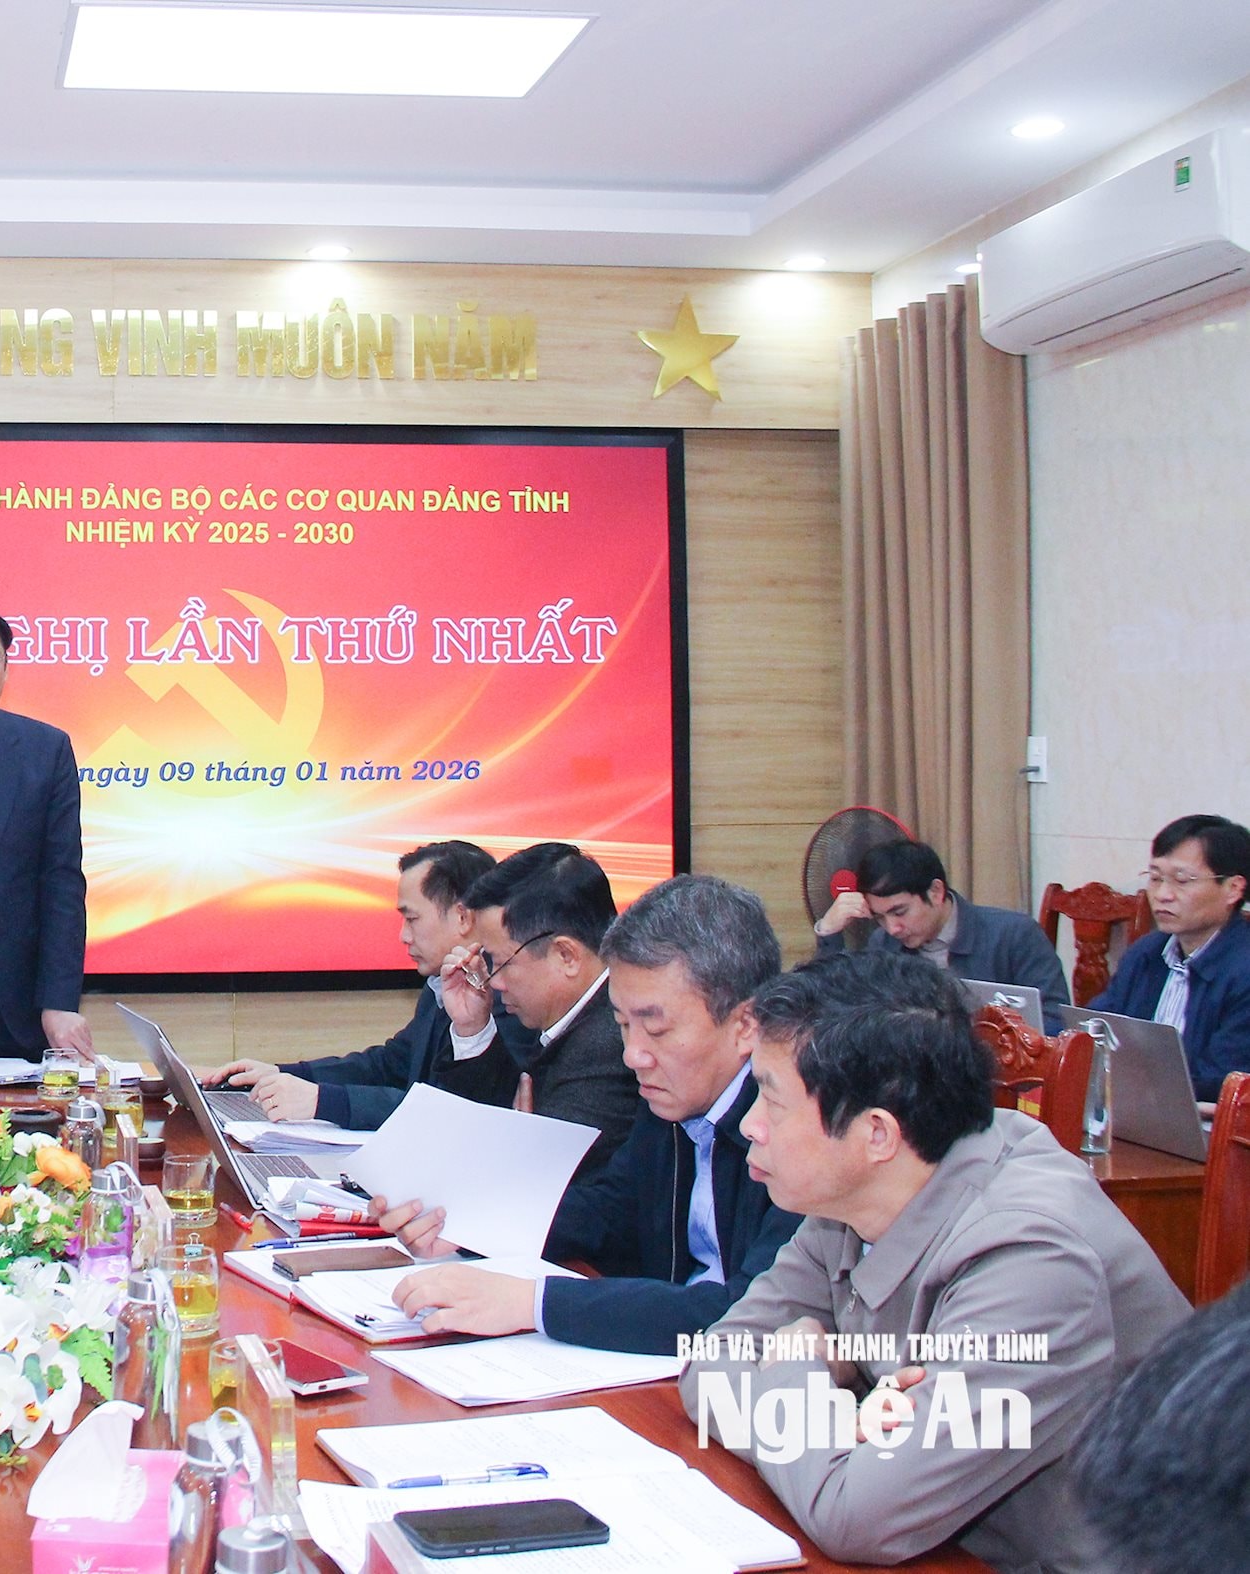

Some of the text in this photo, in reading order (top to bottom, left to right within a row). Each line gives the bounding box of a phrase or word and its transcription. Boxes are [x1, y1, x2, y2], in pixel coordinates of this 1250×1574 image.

[91, 309, 218, 377] VINH
[236, 297, 394, 380] MUÔN
[411, 300, 539, 381] NĂM
[80, 483, 162, 510] ĐẢNG
[170, 485, 212, 516] BỘ
[219, 483, 278, 511] CÁC
[286, 489, 330, 512] CƠ
[336, 490, 415, 513] QUAN
[422, 485, 501, 513] ĐẢNG
[508, 486, 570, 513] TỈNH
[65, 518, 154, 548] NHIỆM
[163, 516, 201, 543] KỲ
[208, 522, 270, 544] 2025
[293, 522, 355, 545] 2030
[4, 614, 109, 677] GHỊ
[125, 596, 264, 664] LẦN
[278, 604, 418, 664] THỨ
[432, 597, 618, 664] NHẤT
[78, 760, 481, 788] ngày 09 tháng 01 năm 2026
